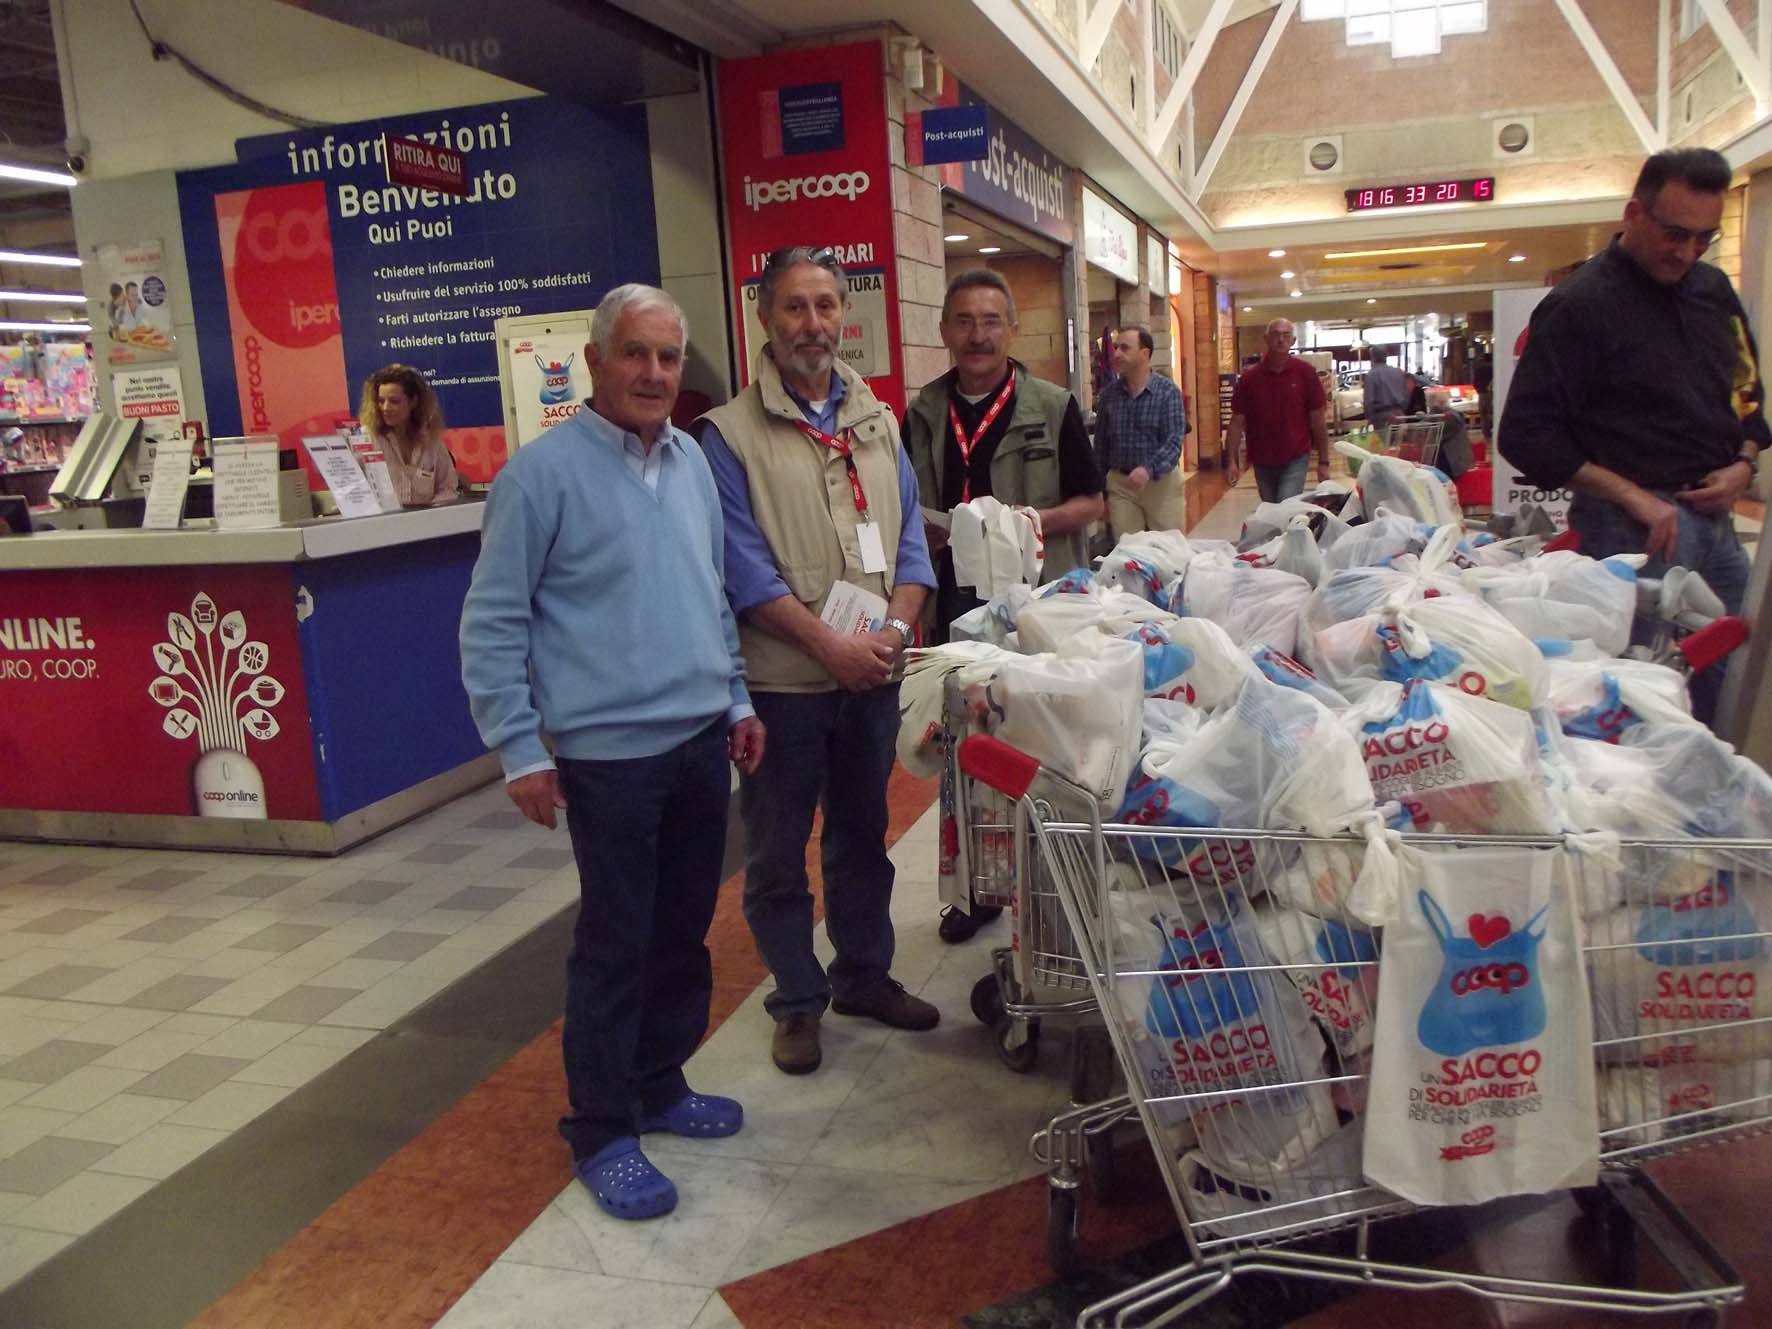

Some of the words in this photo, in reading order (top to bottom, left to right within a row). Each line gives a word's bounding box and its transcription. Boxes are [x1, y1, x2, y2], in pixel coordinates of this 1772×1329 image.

[925, 127, 984, 142] Post-acquisti
[392, 142, 435, 168] RITIRA
[438, 153, 461, 175] QUI
[744, 171, 870, 212] ipercoop
[1359, 191, 1373, 206] 18
[1380, 189, 1394, 205] 16
[1405, 186, 1426, 203] 33
[1437, 183, 1458, 200] 20
[368, 219, 402, 245] Qui
[407, 216, 453, 241] Puoi
[380, 263, 425, 279] Chiedere
[428, 256, 495, 276] informazioni
[383, 287, 431, 302] Usufruire
[434, 285, 450, 298] del
[453, 281, 494, 296] servizio
[498, 278, 529, 292] 100%
[532, 272, 591, 288] soddisfatti
[386, 311, 409, 326] Farti
[412, 307, 469, 325] autorizzare
[473, 304, 521, 319] l'assegno
[390, 332, 444, 349] Richiedere
[447, 332, 457, 344] la
[460, 330, 496, 344] fattura
[124, 406, 149, 416] BUONI
[150, 403, 179, 414] PASTO
[0, 617, 96, 650] NLINE.
[42, 659, 100, 679] COOP.
[1363, 721, 1450, 763] ACCO
[226, 789, 259, 802] online
[1655, 970, 1757, 1000] SACCO
[1173, 1024, 1272, 1066] SACCO
[1420, 1072, 1440, 1085] UN
[1441, 1049, 1542, 1086] SACCO
[1409, 1088, 1423, 1102] DI
